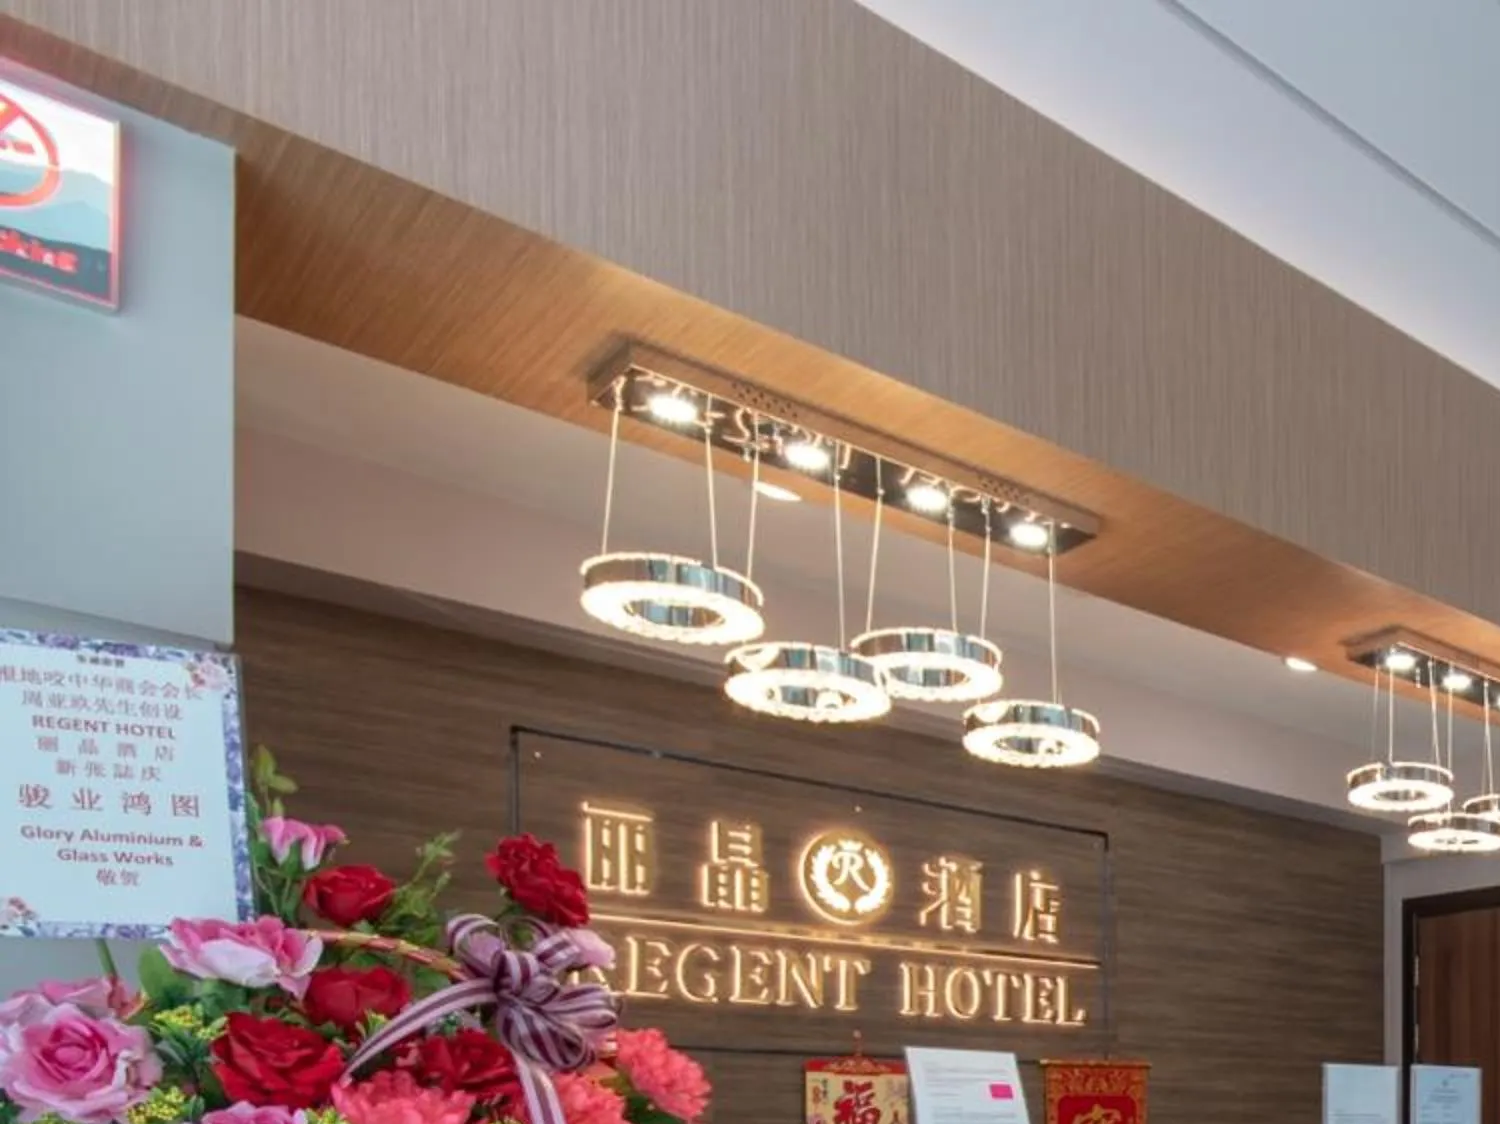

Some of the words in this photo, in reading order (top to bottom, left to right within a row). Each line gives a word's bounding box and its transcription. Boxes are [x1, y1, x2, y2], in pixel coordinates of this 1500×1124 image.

[32, 715, 109, 734] REGENT
[115, 723, 176, 740] HOTEL
[20, 825, 74, 842] Glory
[80, 828, 183, 847] Aluminium
[188, 835, 203, 848] &
[56, 848, 109, 863] Glass
[113, 851, 174, 866] Works
[919, 855, 1062, 944] 酒店
[900, 961, 1087, 1027] HOTEL
